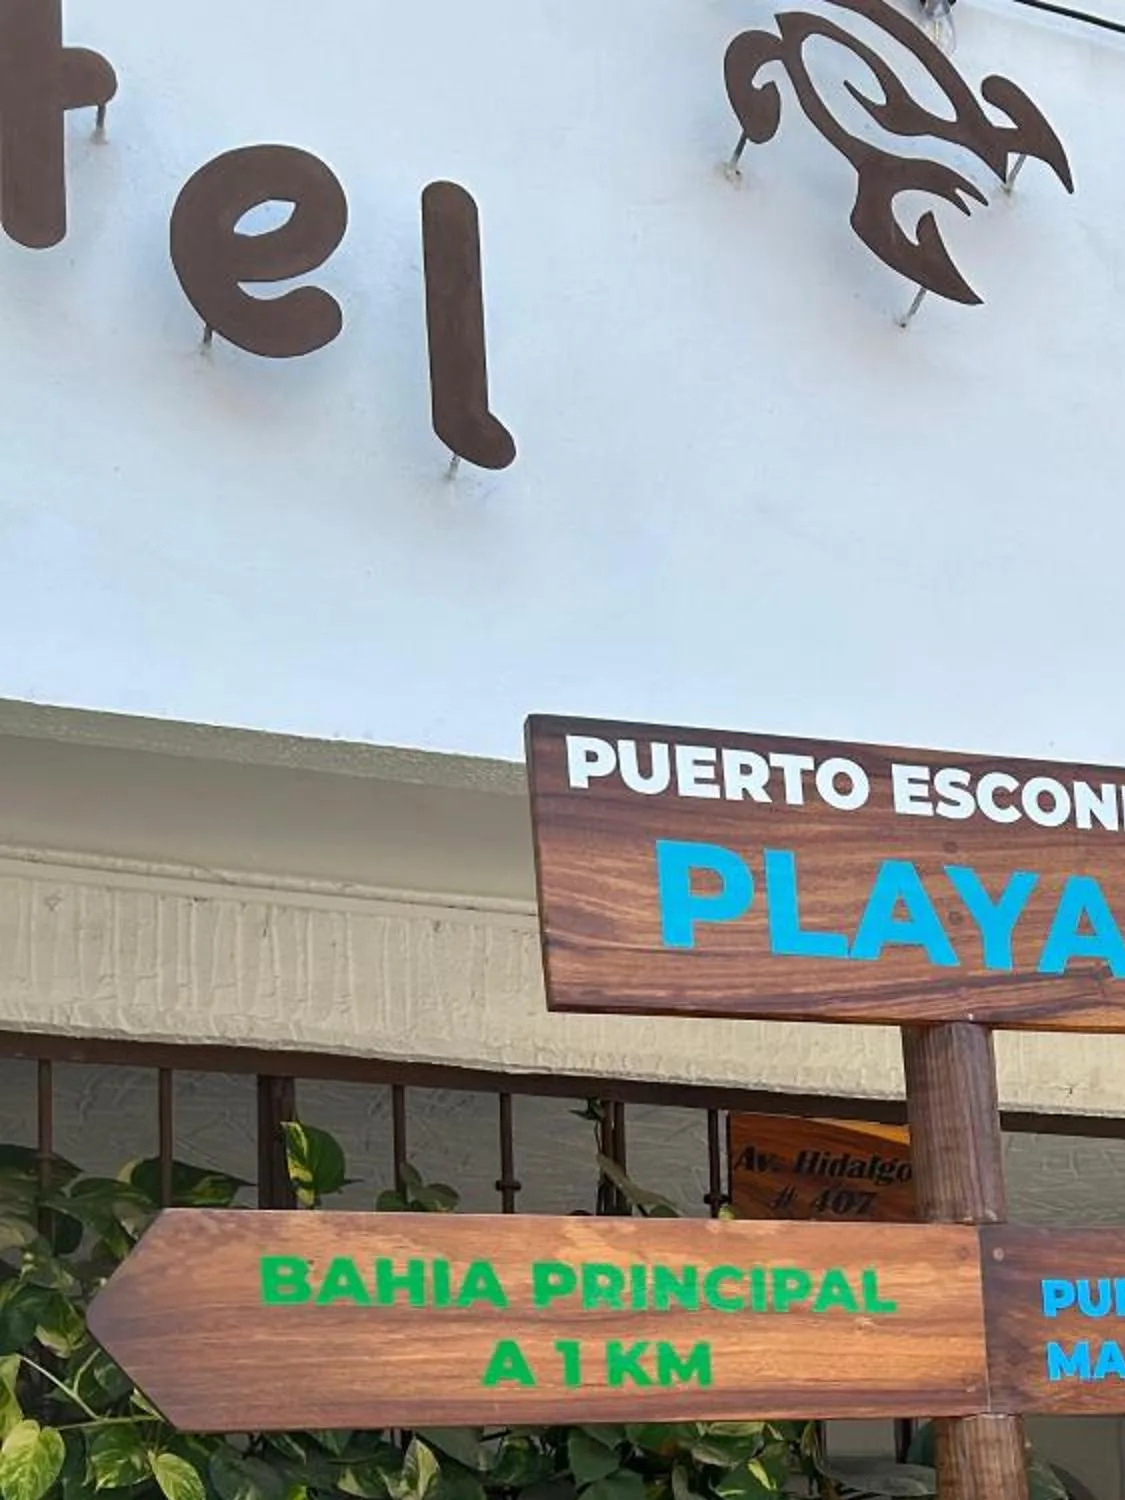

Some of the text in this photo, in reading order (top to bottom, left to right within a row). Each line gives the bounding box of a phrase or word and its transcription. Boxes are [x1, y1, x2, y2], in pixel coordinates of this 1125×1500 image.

[565, 735, 869, 811] PUERTO
[793, 1150, 912, 1186] Hidalgo
[811, 1189, 877, 1215] 407
[261, 1257, 896, 1312] BAHIA PRINCIPAL
[484, 1341, 711, 1386] A 1 KM
